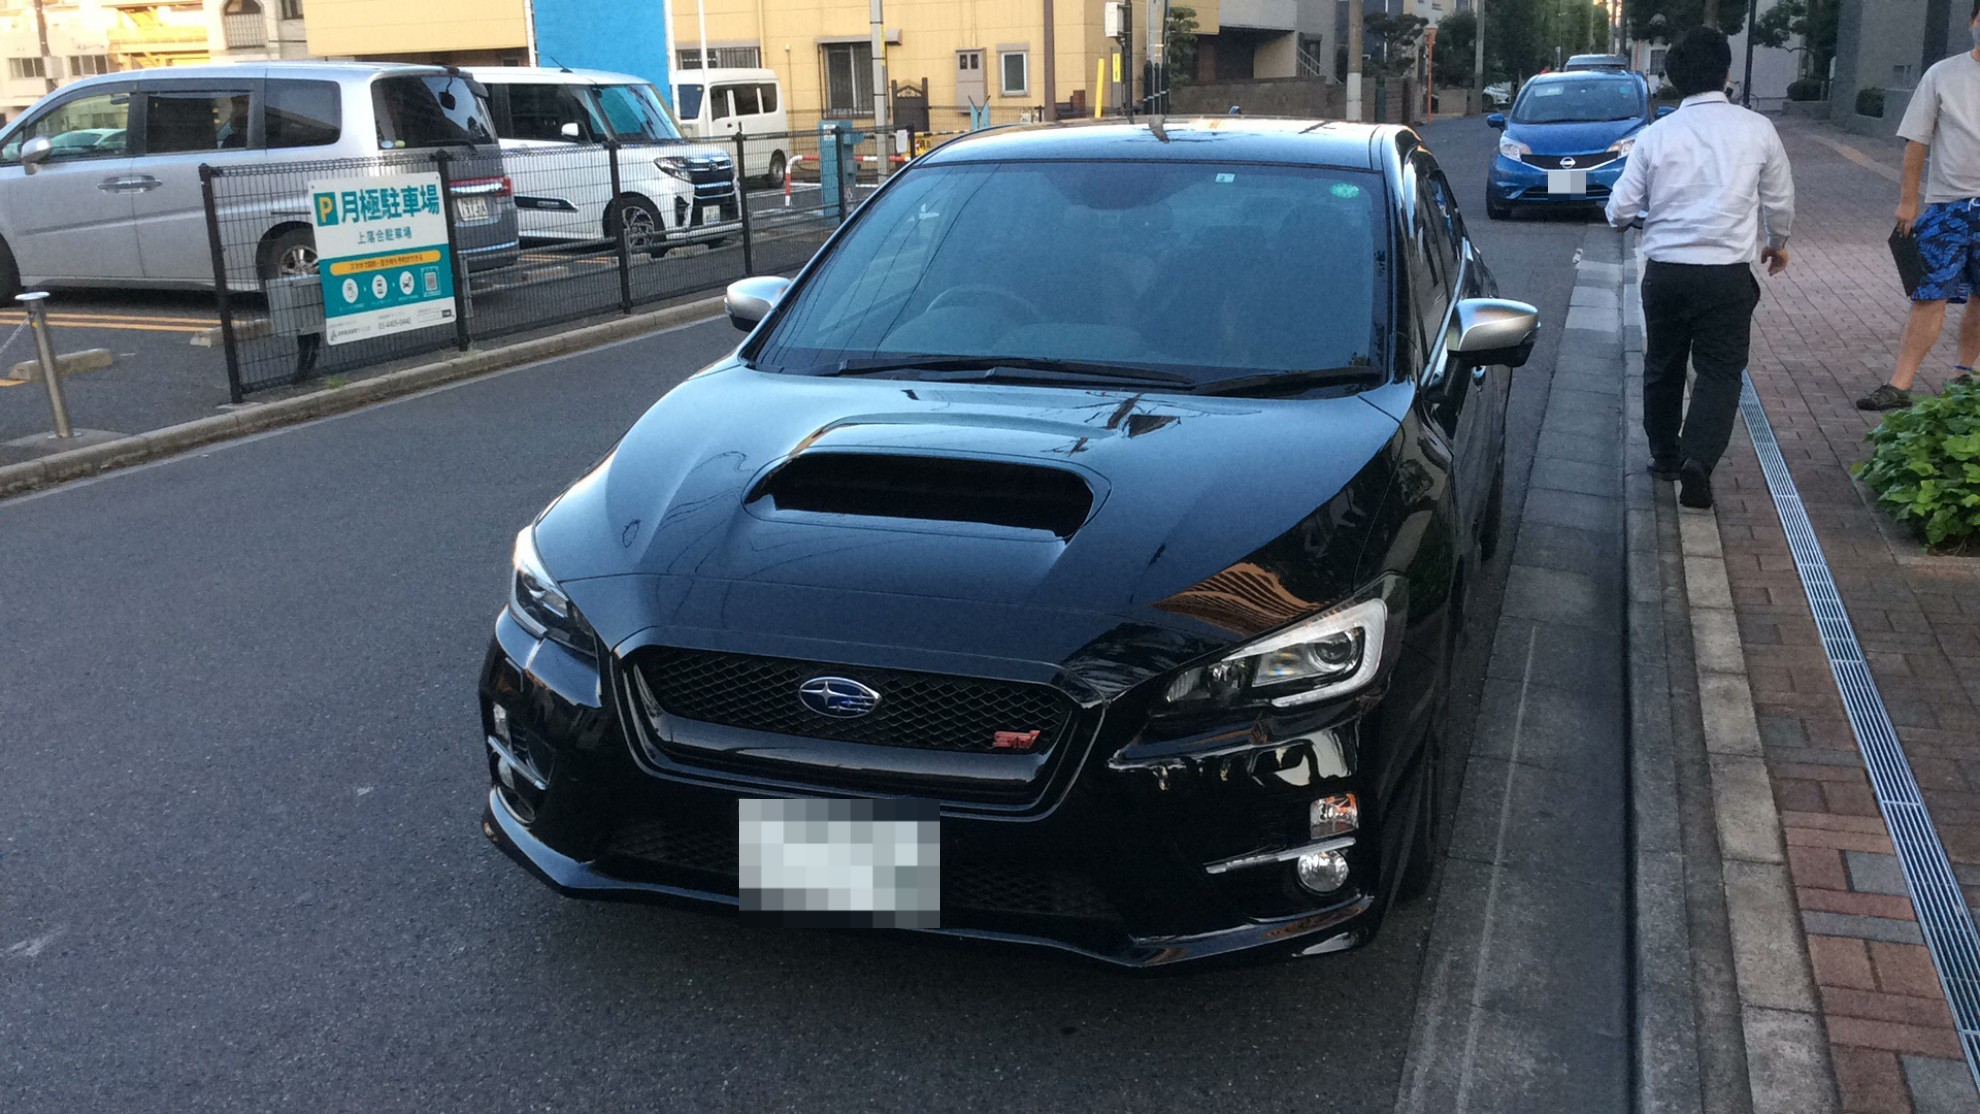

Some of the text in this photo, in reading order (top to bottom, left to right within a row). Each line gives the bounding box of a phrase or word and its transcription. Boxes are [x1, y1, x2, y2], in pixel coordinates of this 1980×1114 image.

[319, 196, 333, 223] P
[340, 184, 440, 223] 月極駐車場
[358, 226, 412, 244] 上落合駐車場
